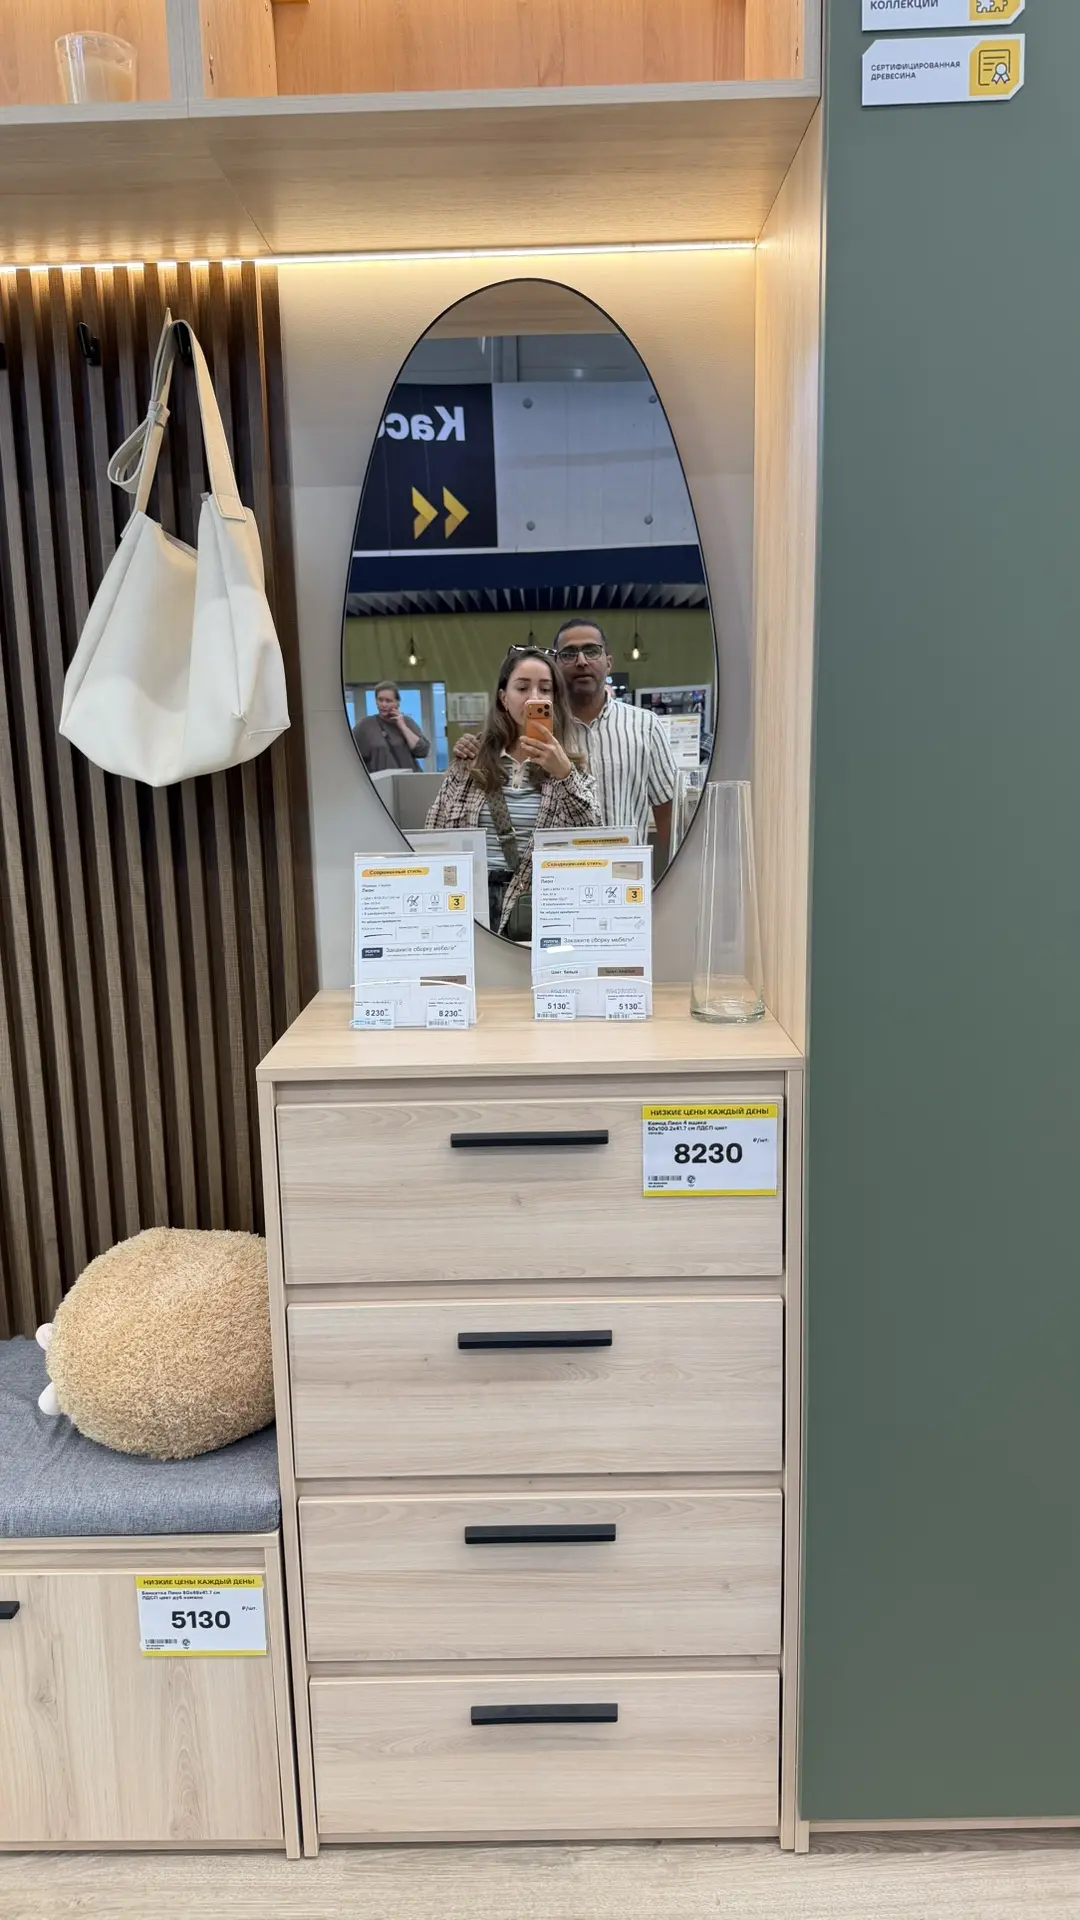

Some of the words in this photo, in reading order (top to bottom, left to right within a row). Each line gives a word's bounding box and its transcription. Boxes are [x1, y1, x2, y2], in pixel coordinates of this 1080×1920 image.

[871, 61, 961, 72] СЕРТИФИЦИРОВАННАЯ
[870, 73, 917, 81] ДРЕВЕСИНА
[631, 890, 638, 899] 3
[453, 898, 460, 906] 3
[708, 1108, 744, 1116] КАЖДЫЙ
[674, 1143, 743, 1164] 8230
[171, 1610, 231, 1629] 5130
